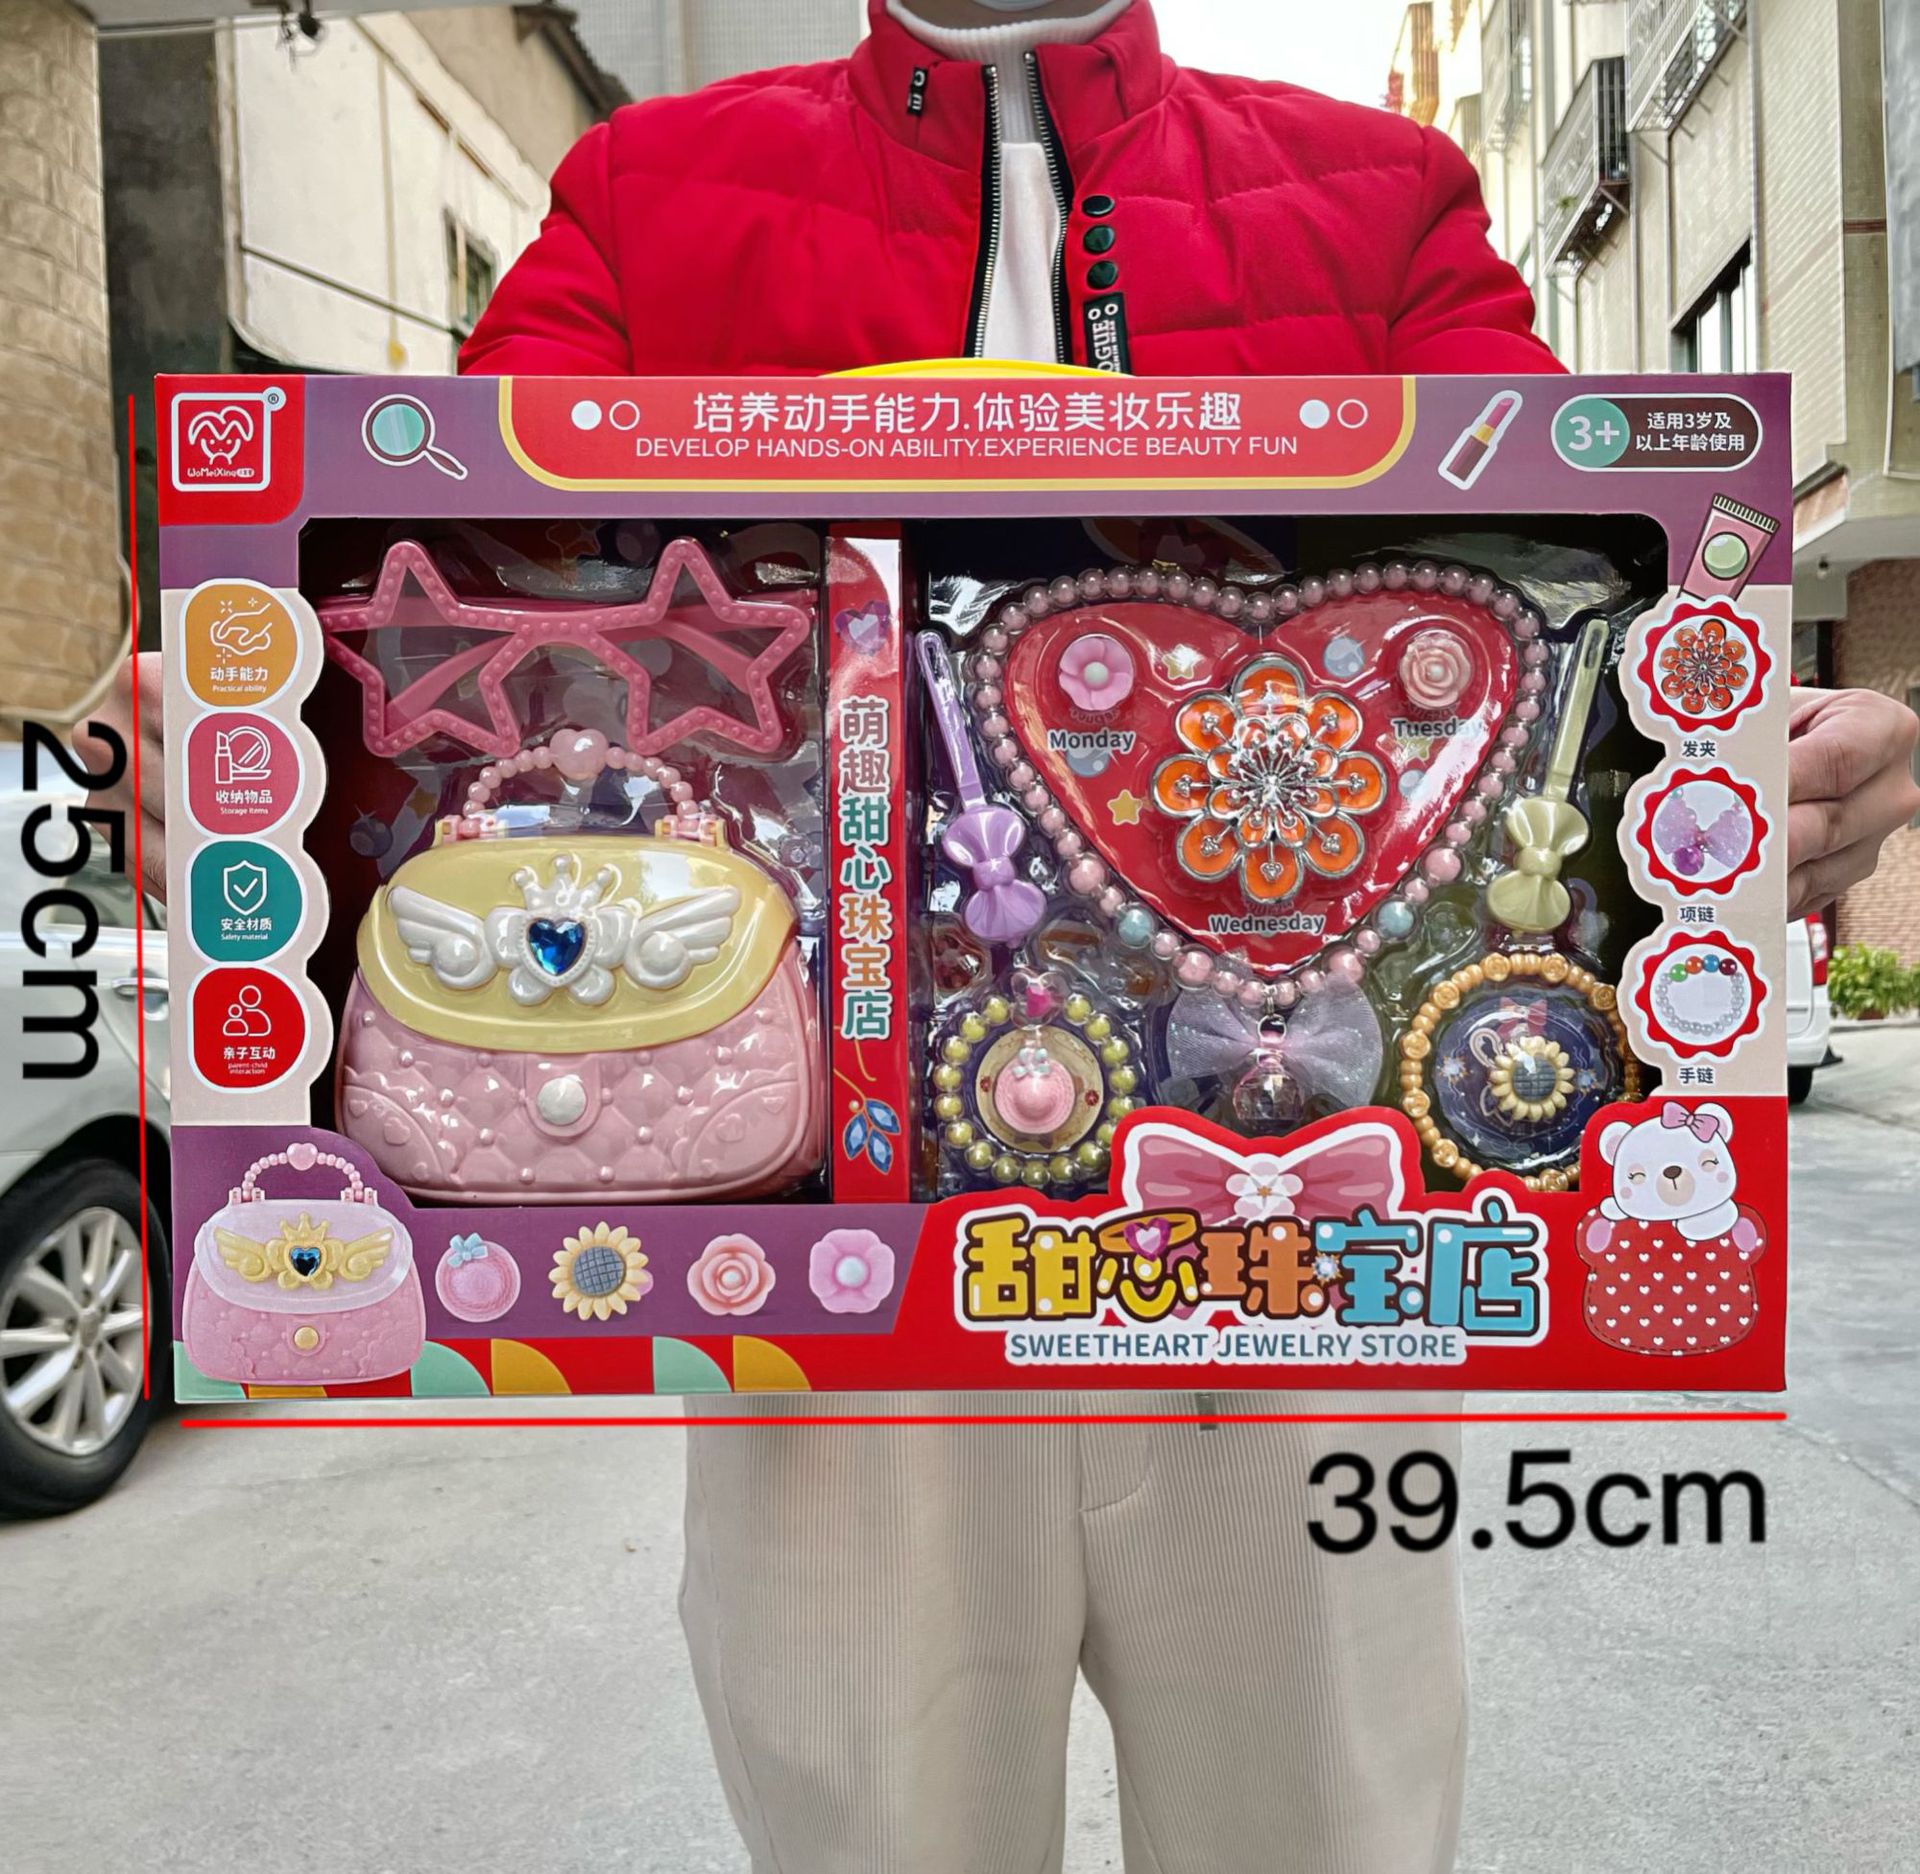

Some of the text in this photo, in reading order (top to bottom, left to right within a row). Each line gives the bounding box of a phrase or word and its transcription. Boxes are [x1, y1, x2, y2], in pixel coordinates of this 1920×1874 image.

[1092, 319, 1114, 372] OGUE
[694, 392, 1242, 433] 培养动手能力.体验美妆乐趣
[1647, 412, 1732, 430] 适用3岁及
[1567, 414, 1621, 452] 3+
[1635, 433, 1745, 452] 以上年龄使用
[636, 437, 750, 457] DEVELOP
[756, 437, 884, 457] HANDS-ON
[1145, 436, 1242, 456] BEAUTY
[1249, 435, 1297, 455] FUN
[210, 666, 269, 682] 动手能力
[1393, 717, 1483, 739] Tuesd
[1049, 729, 1134, 753] Monday
[1682, 740, 1716, 758] 发夹
[216, 789, 273, 804] 收纳物品
[840, 697, 891, 1037] 萌趣甜心珠宝店
[221, 917, 272, 931] 安全材质
[1210, 912, 1325, 934] Wednesday
[1680, 906, 1715, 923] 项链
[224, 1047, 276, 1060] 亲子互动
[1679, 1067, 1715, 1084] 手链
[1010, 1333, 1457, 1358] SWEETHEART JEWELRY STORE
